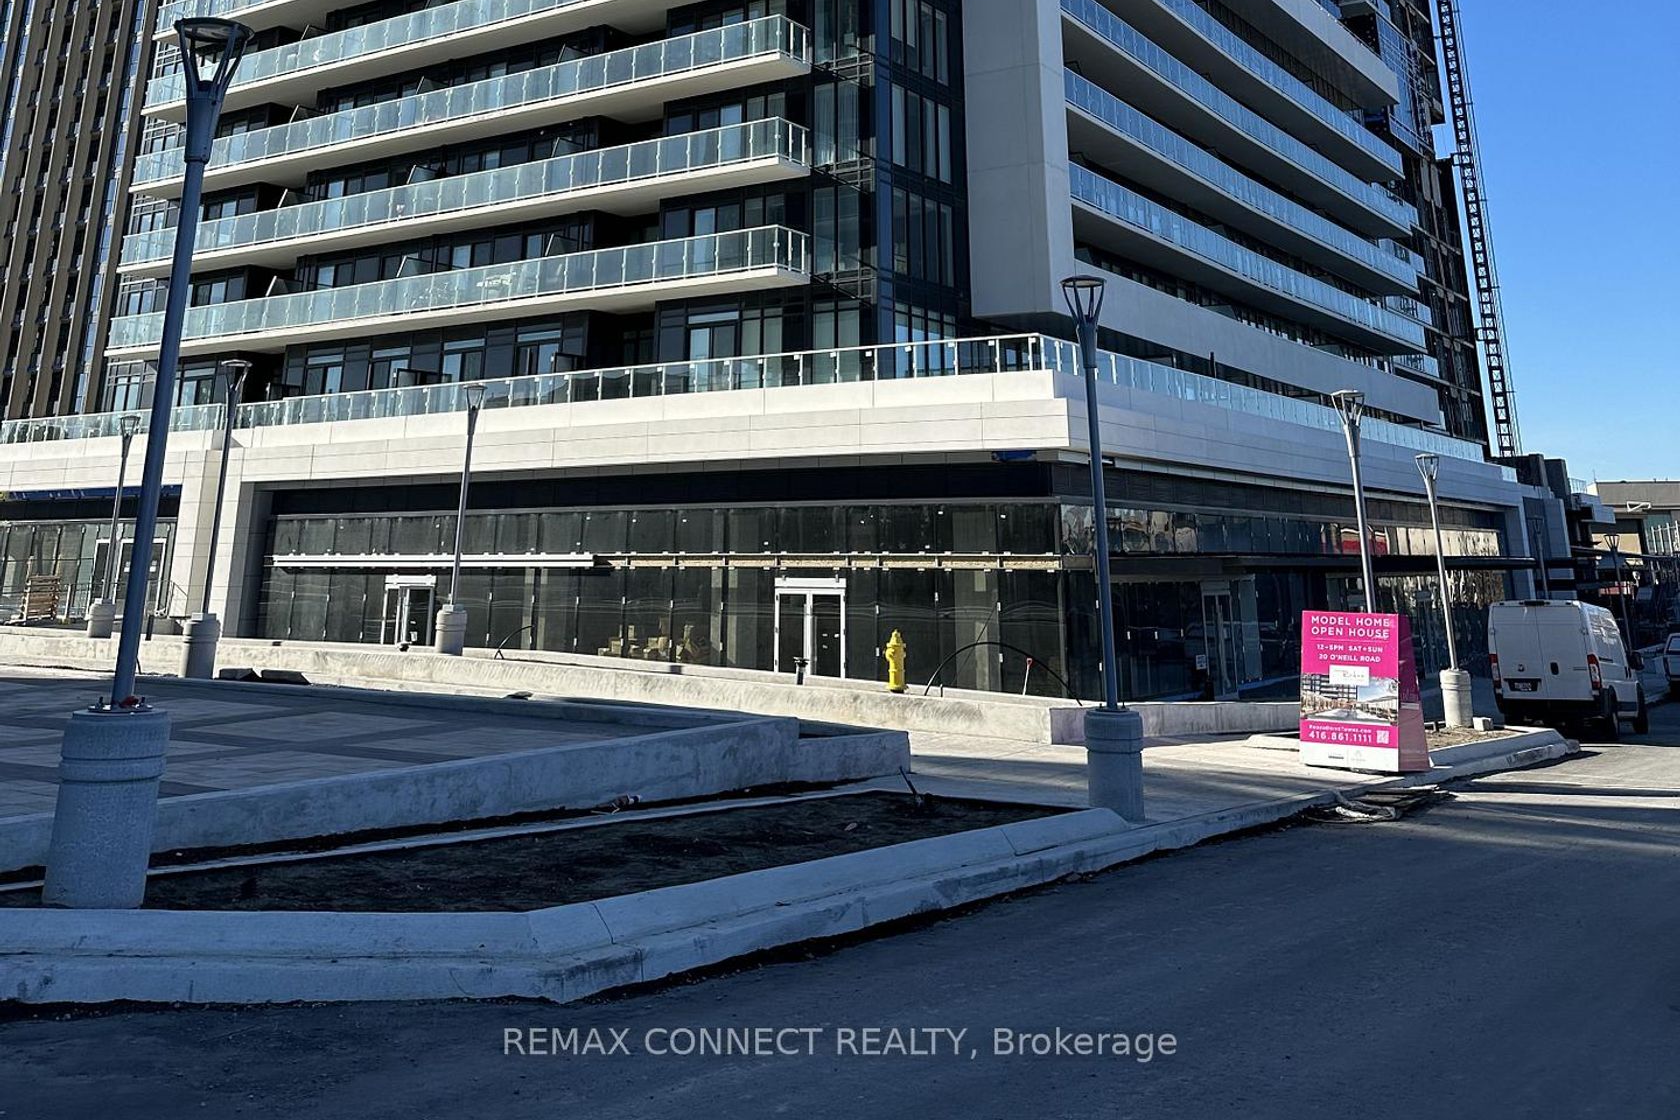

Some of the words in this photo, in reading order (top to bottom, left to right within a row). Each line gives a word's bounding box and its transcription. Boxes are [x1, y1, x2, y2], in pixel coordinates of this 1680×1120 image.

[1311, 615, 1351, 626] MODEL
[1355, 617, 1390, 627] HOME
[1311, 626, 1343, 636] OPEN
[1348, 628, 1390, 639] HOUSE
[1330, 654, 1358, 662] O'NEILL
[1360, 655, 1381, 663] ROAD
[1308, 730, 1371, 743] 416.861.1111
